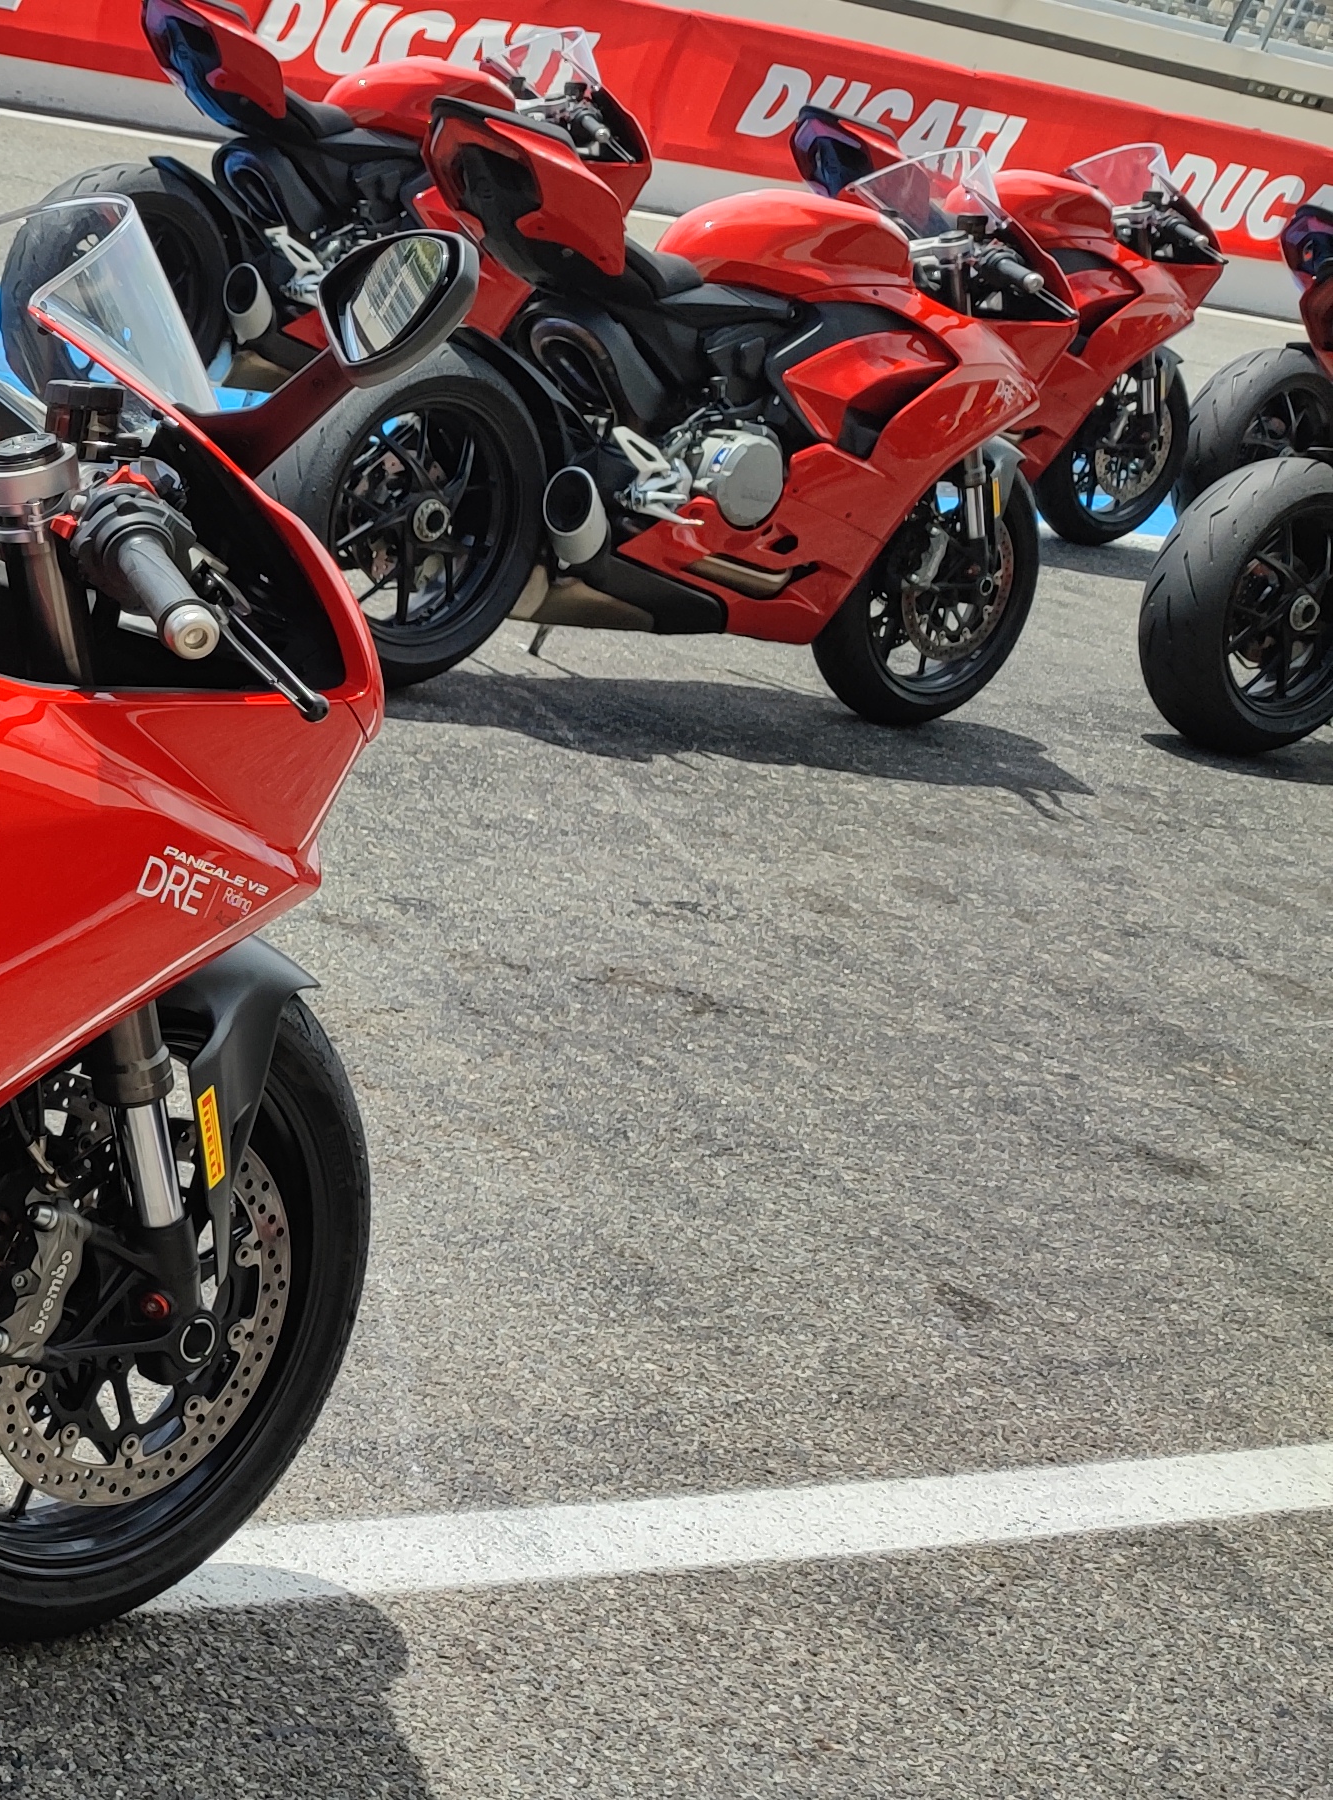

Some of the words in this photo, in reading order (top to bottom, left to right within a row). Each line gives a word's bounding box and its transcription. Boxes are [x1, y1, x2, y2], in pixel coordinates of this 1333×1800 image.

[254, 0, 601, 98] DUCATI
[1170, 153, 1333, 241] DUC
[136, 855, 211, 915] DRE
[164, 846, 247, 887] PANIGALE
[248, 880, 270, 897] V2
[222, 886, 253, 915] Riding
[201, 1092, 222, 1180] PIRELLI
[28, 1250, 73, 1335] brembo
